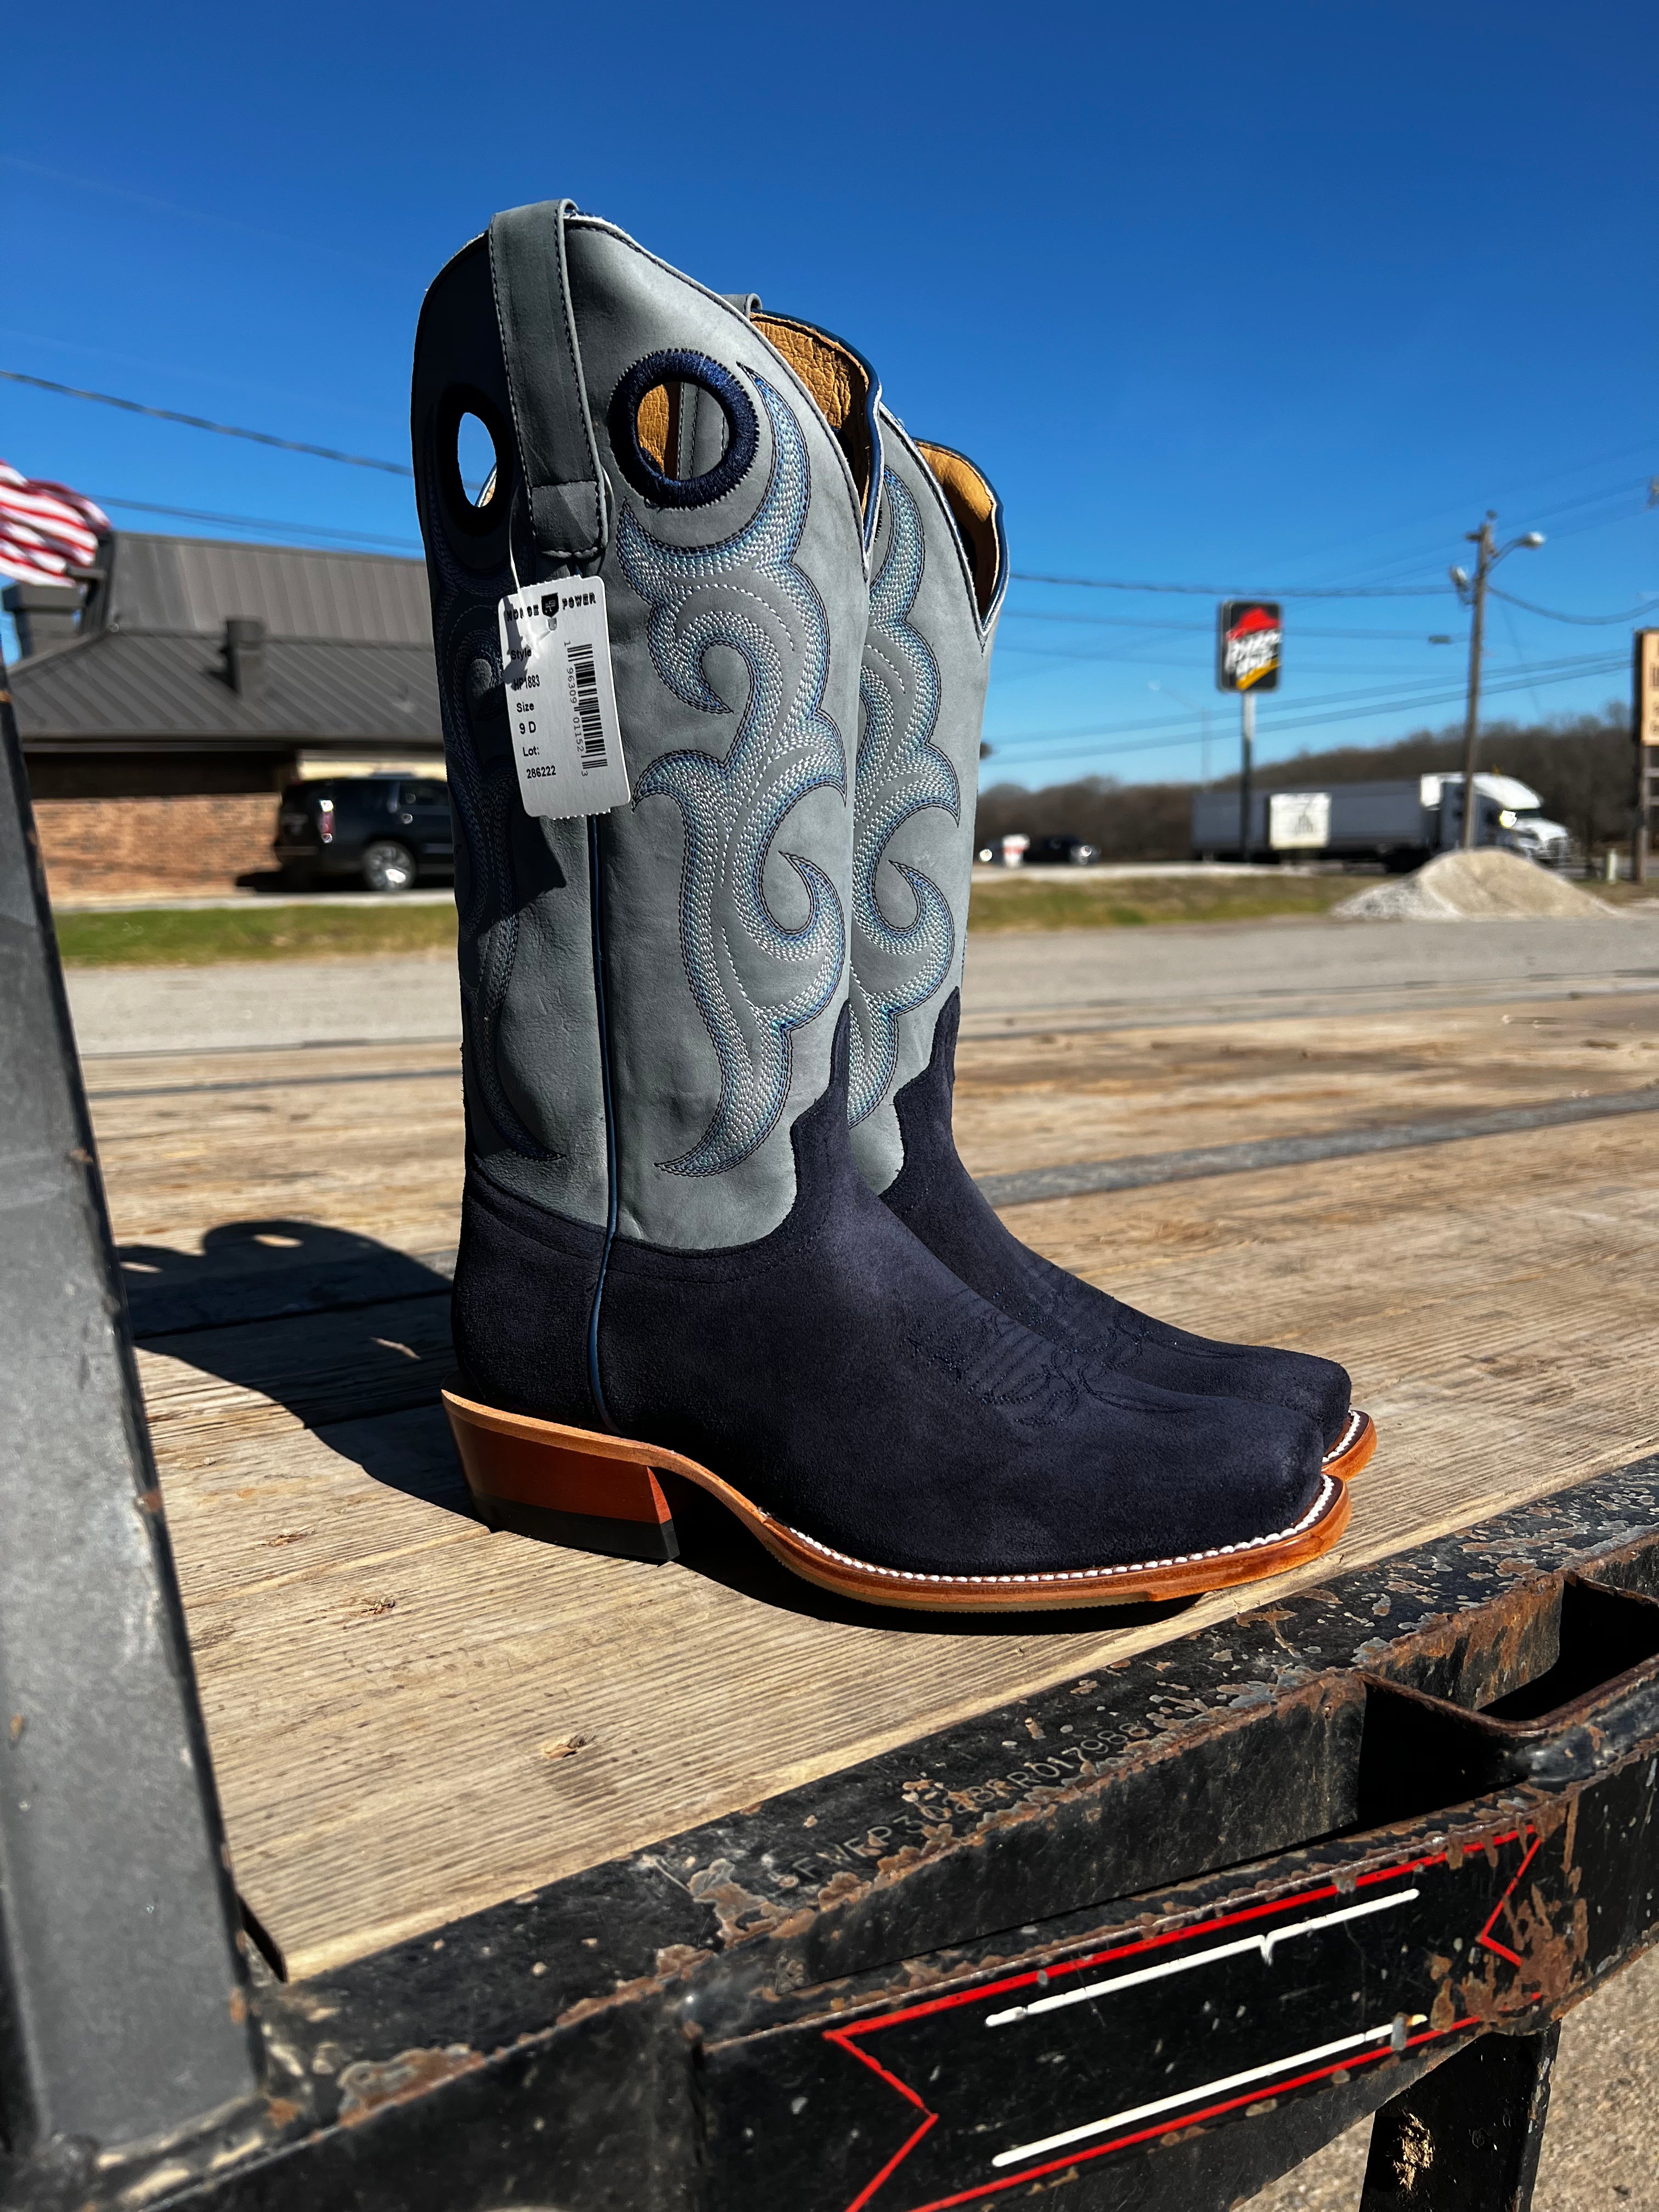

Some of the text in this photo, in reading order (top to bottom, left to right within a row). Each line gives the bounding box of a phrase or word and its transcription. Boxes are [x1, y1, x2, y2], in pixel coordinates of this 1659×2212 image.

[561, 592, 597, 611] POWER
[511, 647, 532, 661] Style
[514, 674, 540, 690] HP1883
[516, 702, 534, 713] Size
[566, 667, 577, 704] 96309
[573, 717, 584, 752] 01152
[519, 721, 537, 735] 9 D
[523, 746, 540, 757] Lot:
[526, 765, 557, 779] 286222
